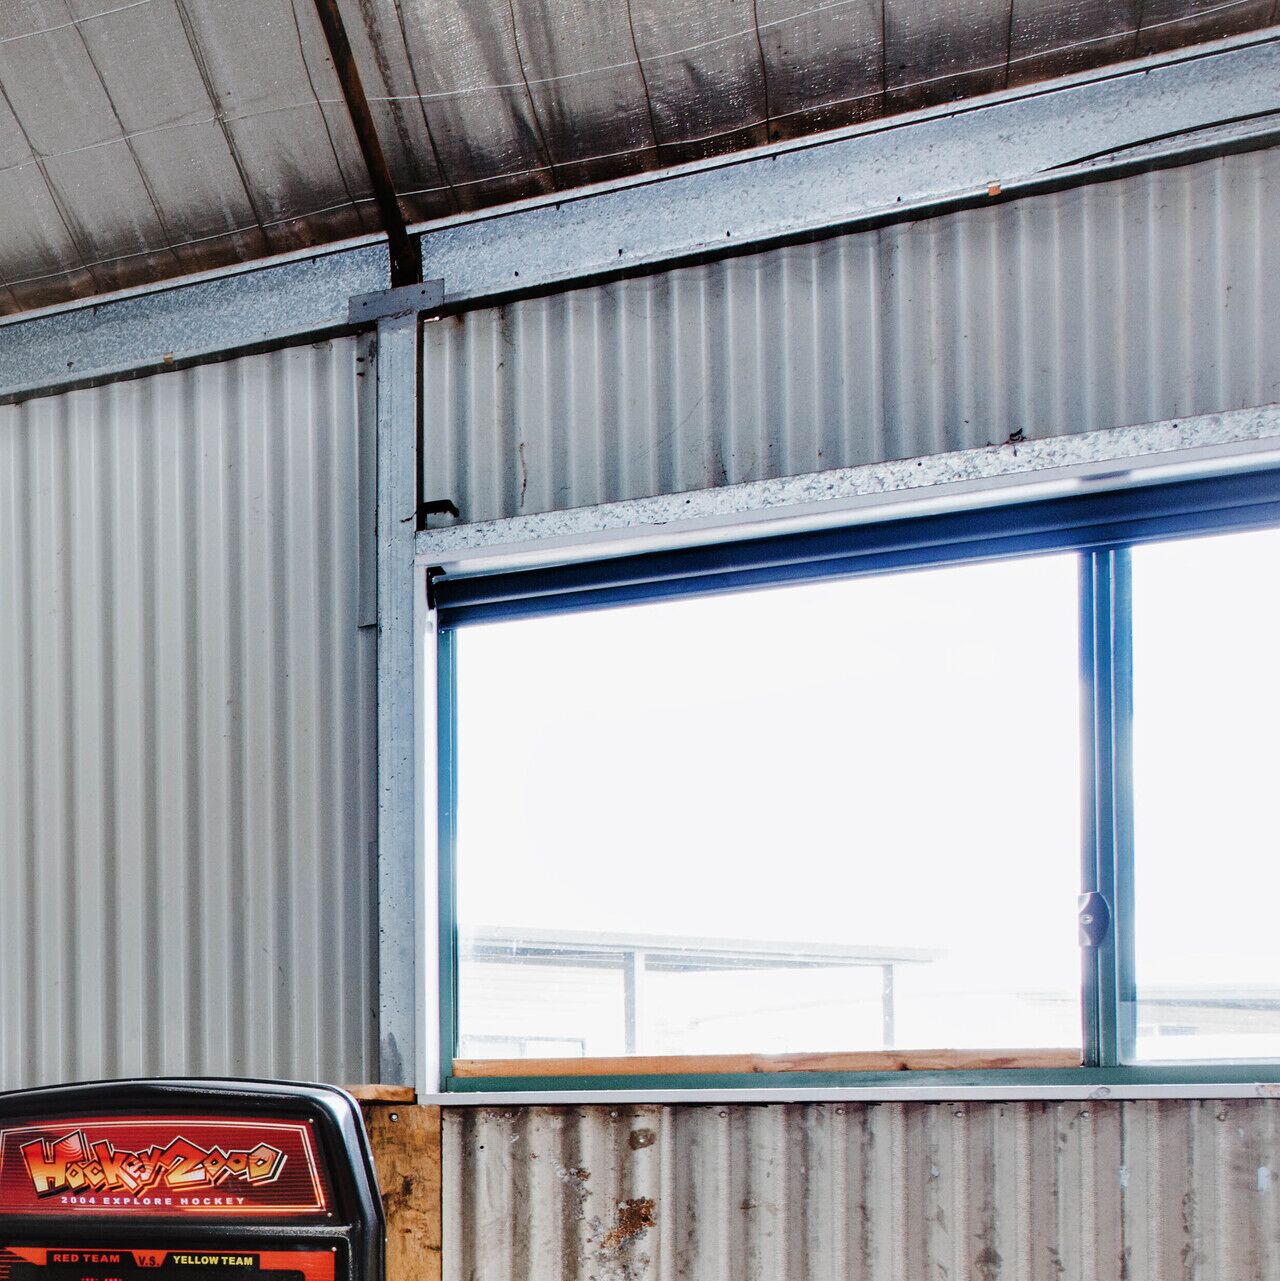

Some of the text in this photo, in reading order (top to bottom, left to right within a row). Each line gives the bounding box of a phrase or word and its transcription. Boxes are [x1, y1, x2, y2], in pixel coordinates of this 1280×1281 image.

[61, 1196, 246, 1206] 2004 EXPLORE HOCKEY
[53, 1253, 254, 1267] RED TEAM V.S. YELLOW TEAM
